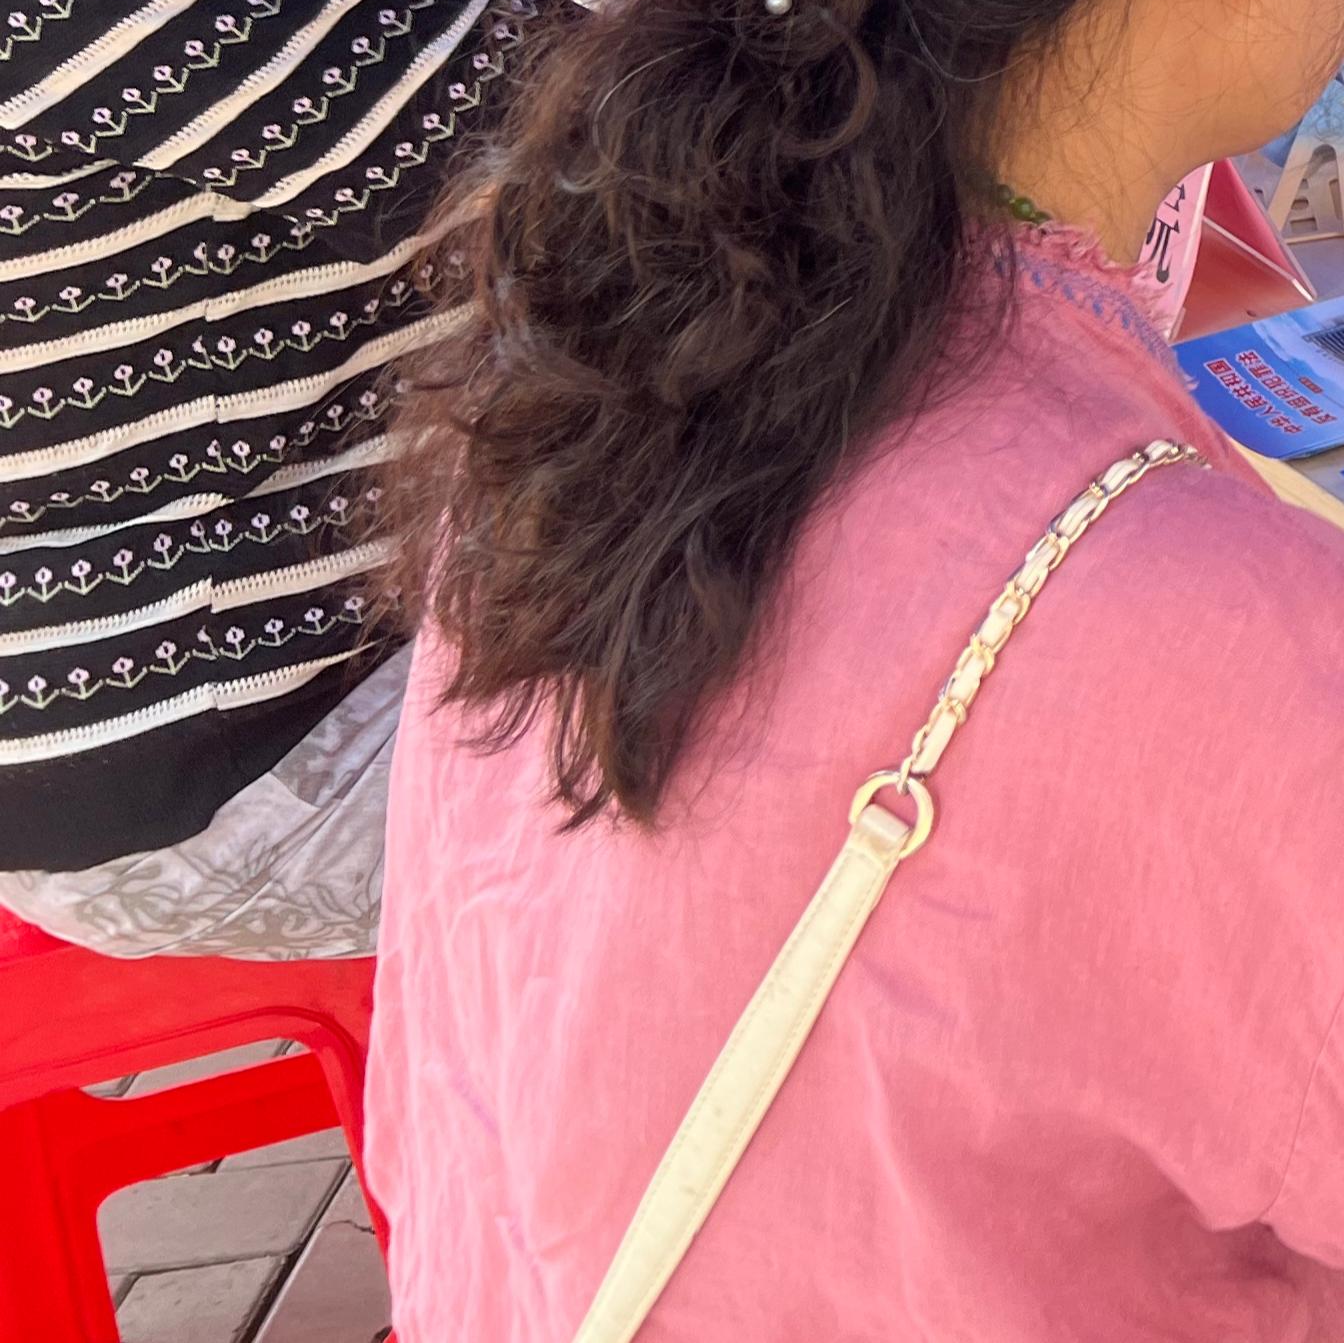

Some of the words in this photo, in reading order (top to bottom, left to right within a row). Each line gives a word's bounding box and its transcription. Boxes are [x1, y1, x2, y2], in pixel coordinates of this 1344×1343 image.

[1203, 358, 1304, 434] 中华人民共和国
[1235, 349, 1338, 425] 反有组织犯罪法
